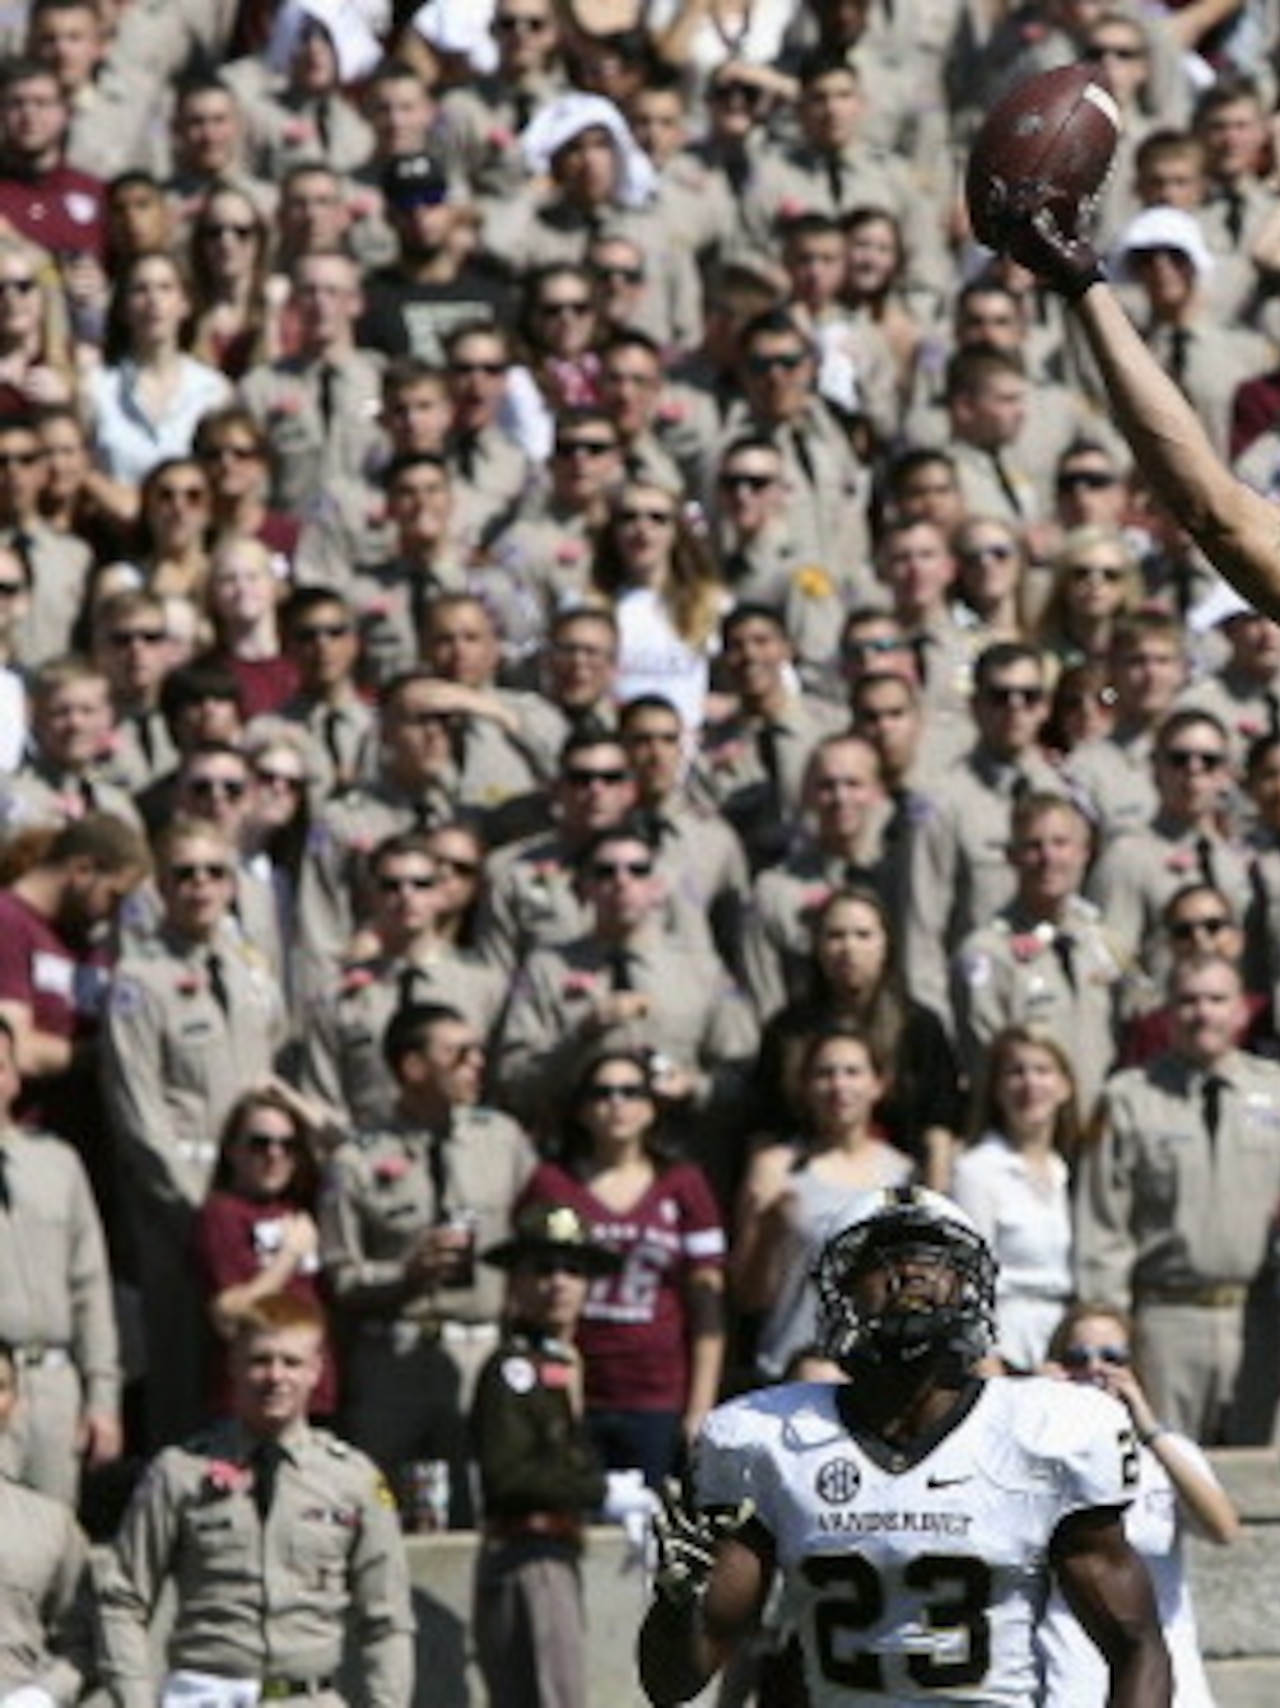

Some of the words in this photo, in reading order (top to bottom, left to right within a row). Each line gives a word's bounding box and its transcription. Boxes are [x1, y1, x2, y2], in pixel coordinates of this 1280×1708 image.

[816, 1456, 862, 1506] SEC
[818, 1511, 973, 1536] VANDERBILT
[803, 1554, 990, 1693] 23
